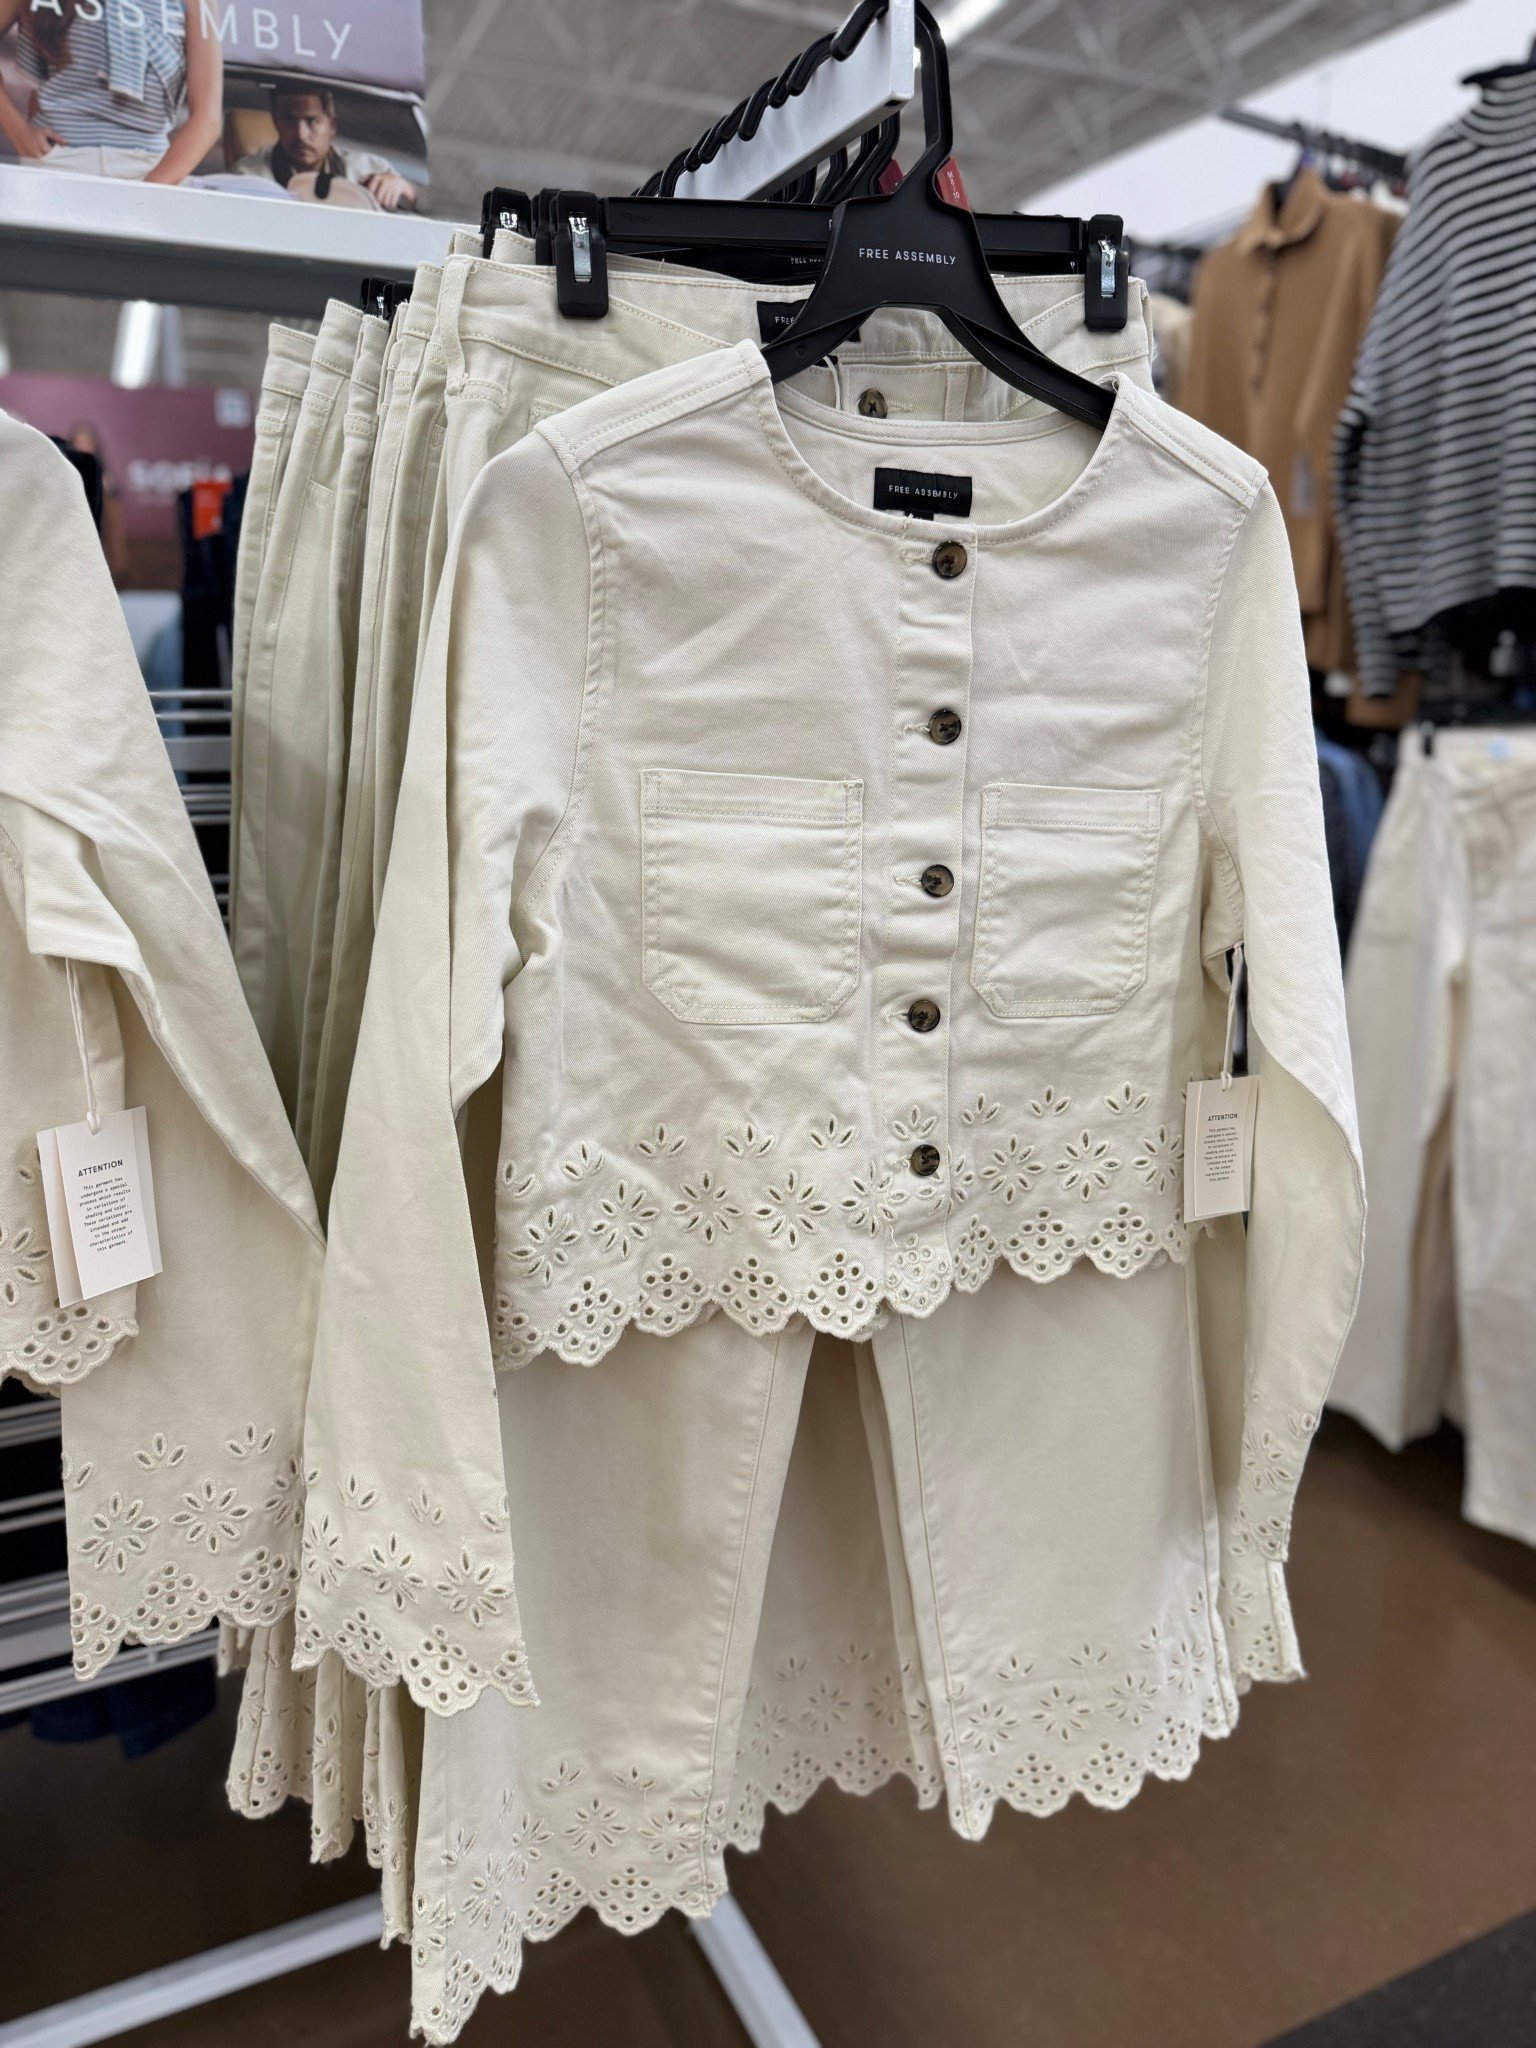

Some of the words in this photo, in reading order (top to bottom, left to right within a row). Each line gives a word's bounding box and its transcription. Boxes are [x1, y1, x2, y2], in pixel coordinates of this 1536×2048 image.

[859, 247, 889, 260] FREE
[895, 250, 956, 265] ASSEMBLY
[888, 484, 910, 495] FREE
[1207, 1112, 1238, 1122] ATTENTION
[78, 1159, 123, 1177] ATTENTION
